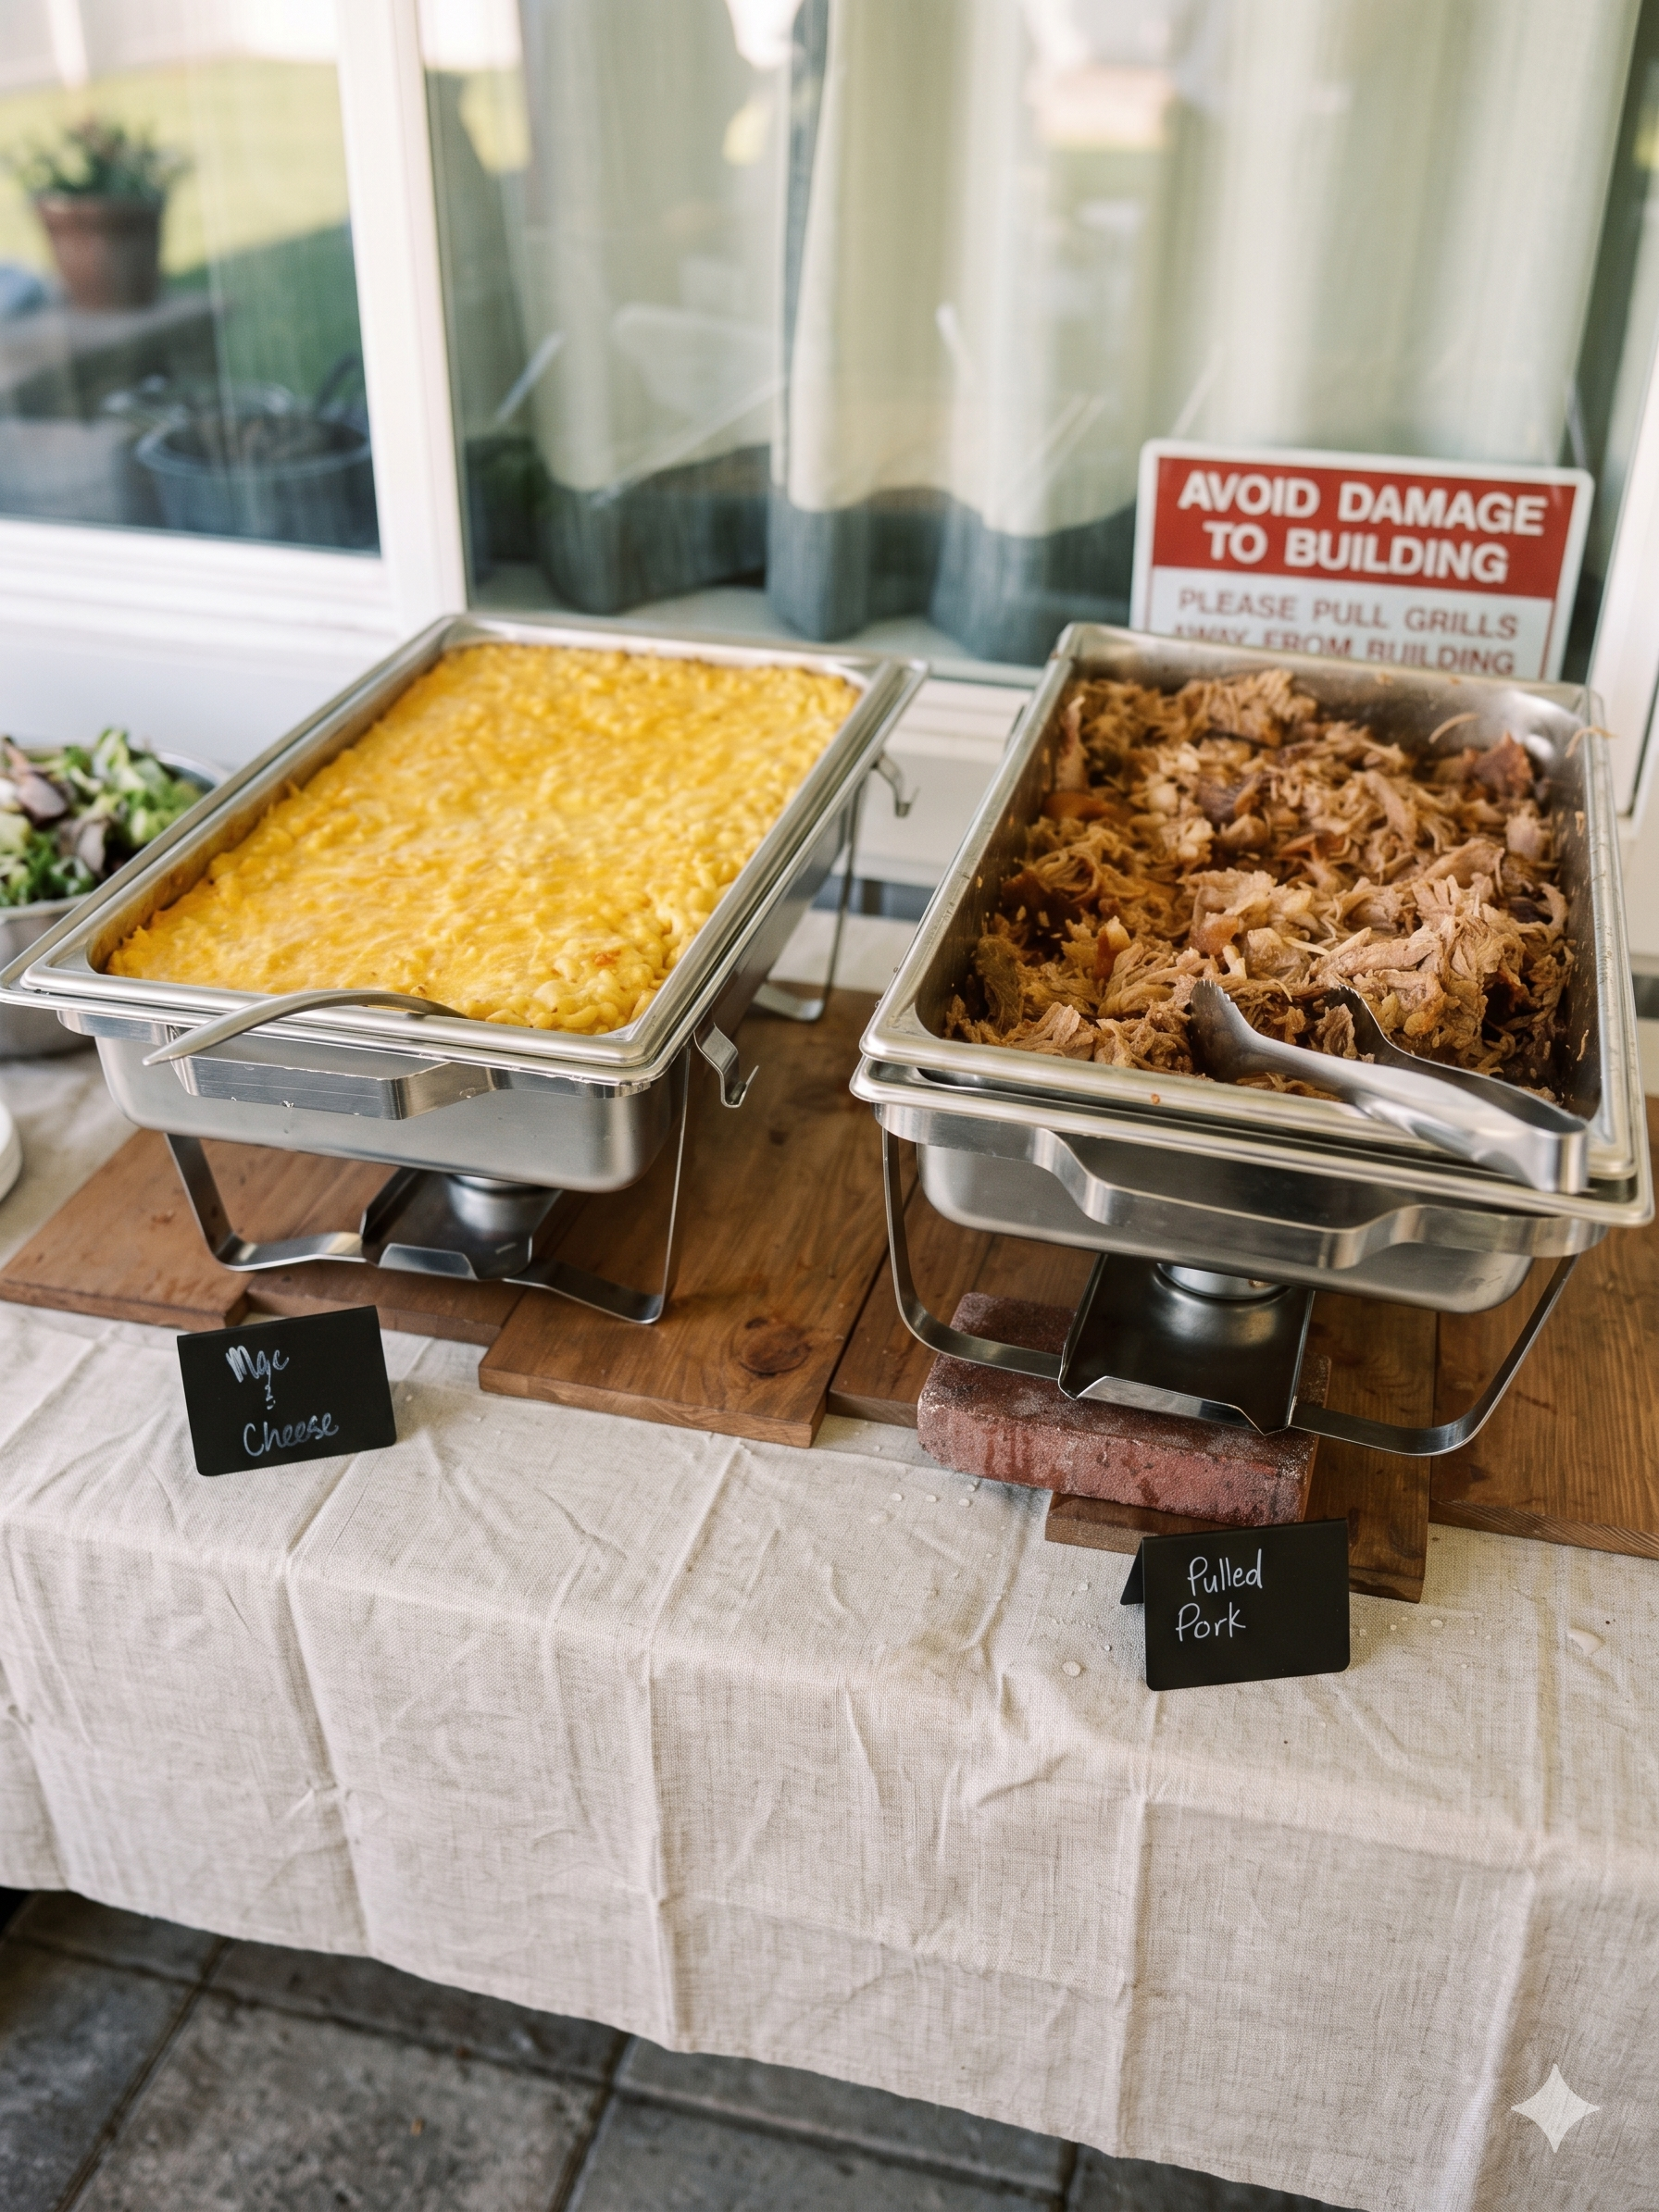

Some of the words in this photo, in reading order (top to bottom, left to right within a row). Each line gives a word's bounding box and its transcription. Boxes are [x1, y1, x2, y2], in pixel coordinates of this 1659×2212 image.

[1177, 469, 1321, 518] AVOID
[1338, 480, 1549, 537] DAMAGE
[1202, 519, 1268, 565] TO
[1284, 527, 1509, 584] BUILDING
[1179, 587, 1297, 621] PLEASE
[1313, 596, 1388, 629] PULL
[1403, 605, 1518, 641] GRILLS
[1263, 629, 1352, 659] FROM
[1366, 639, 1515, 677] BUILDING
[243, 1412, 340, 1457] Cheese
[1187, 1547, 1264, 1597] Pulled
[1175, 1601, 1247, 1643] Pork
